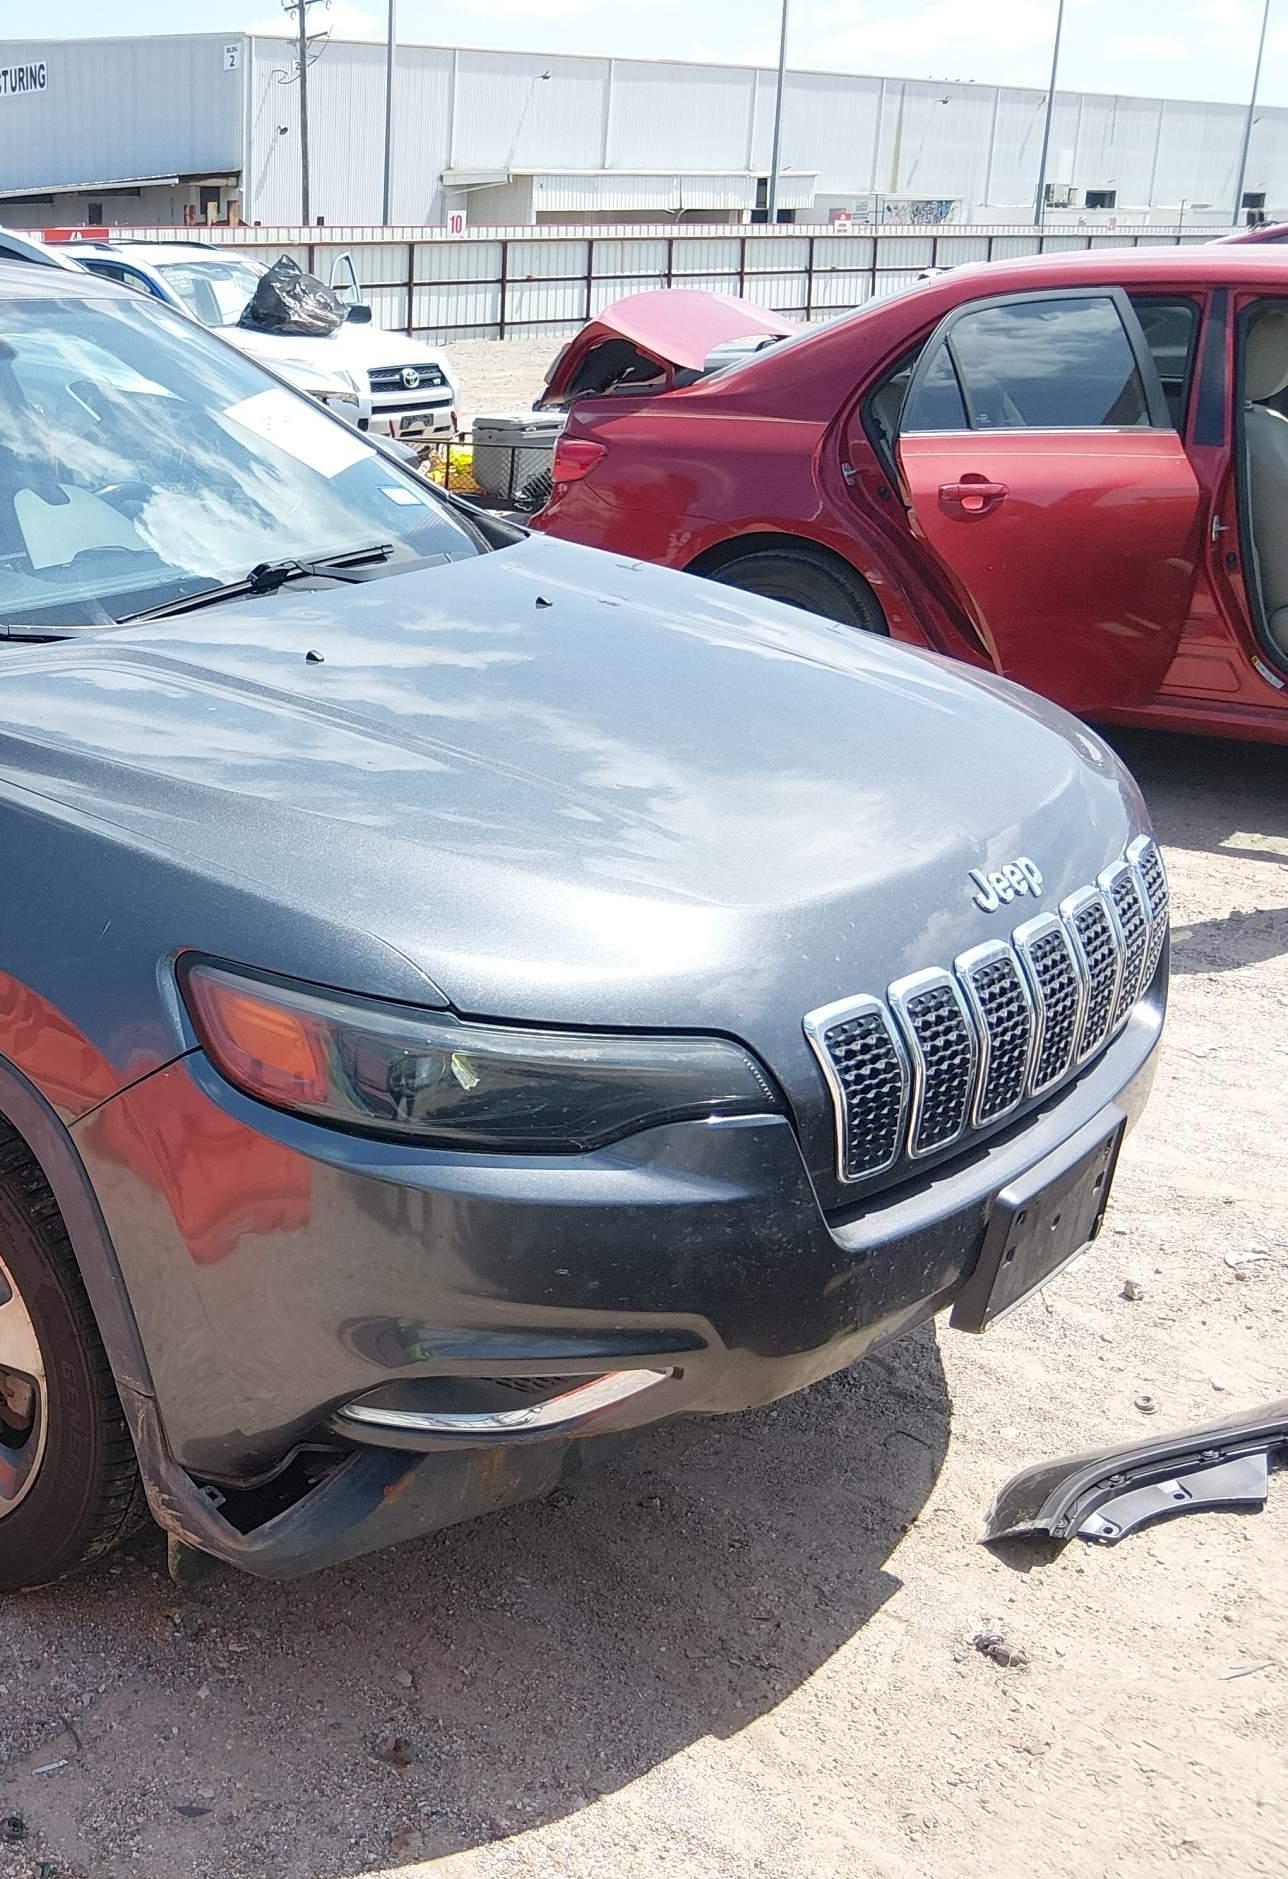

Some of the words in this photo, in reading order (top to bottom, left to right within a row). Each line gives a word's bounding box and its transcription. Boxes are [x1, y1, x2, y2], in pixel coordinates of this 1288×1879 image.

[229, 55, 235, 67] 2
[450, 215, 462, 234] 10
[968, 856, 1043, 913] Jeep
